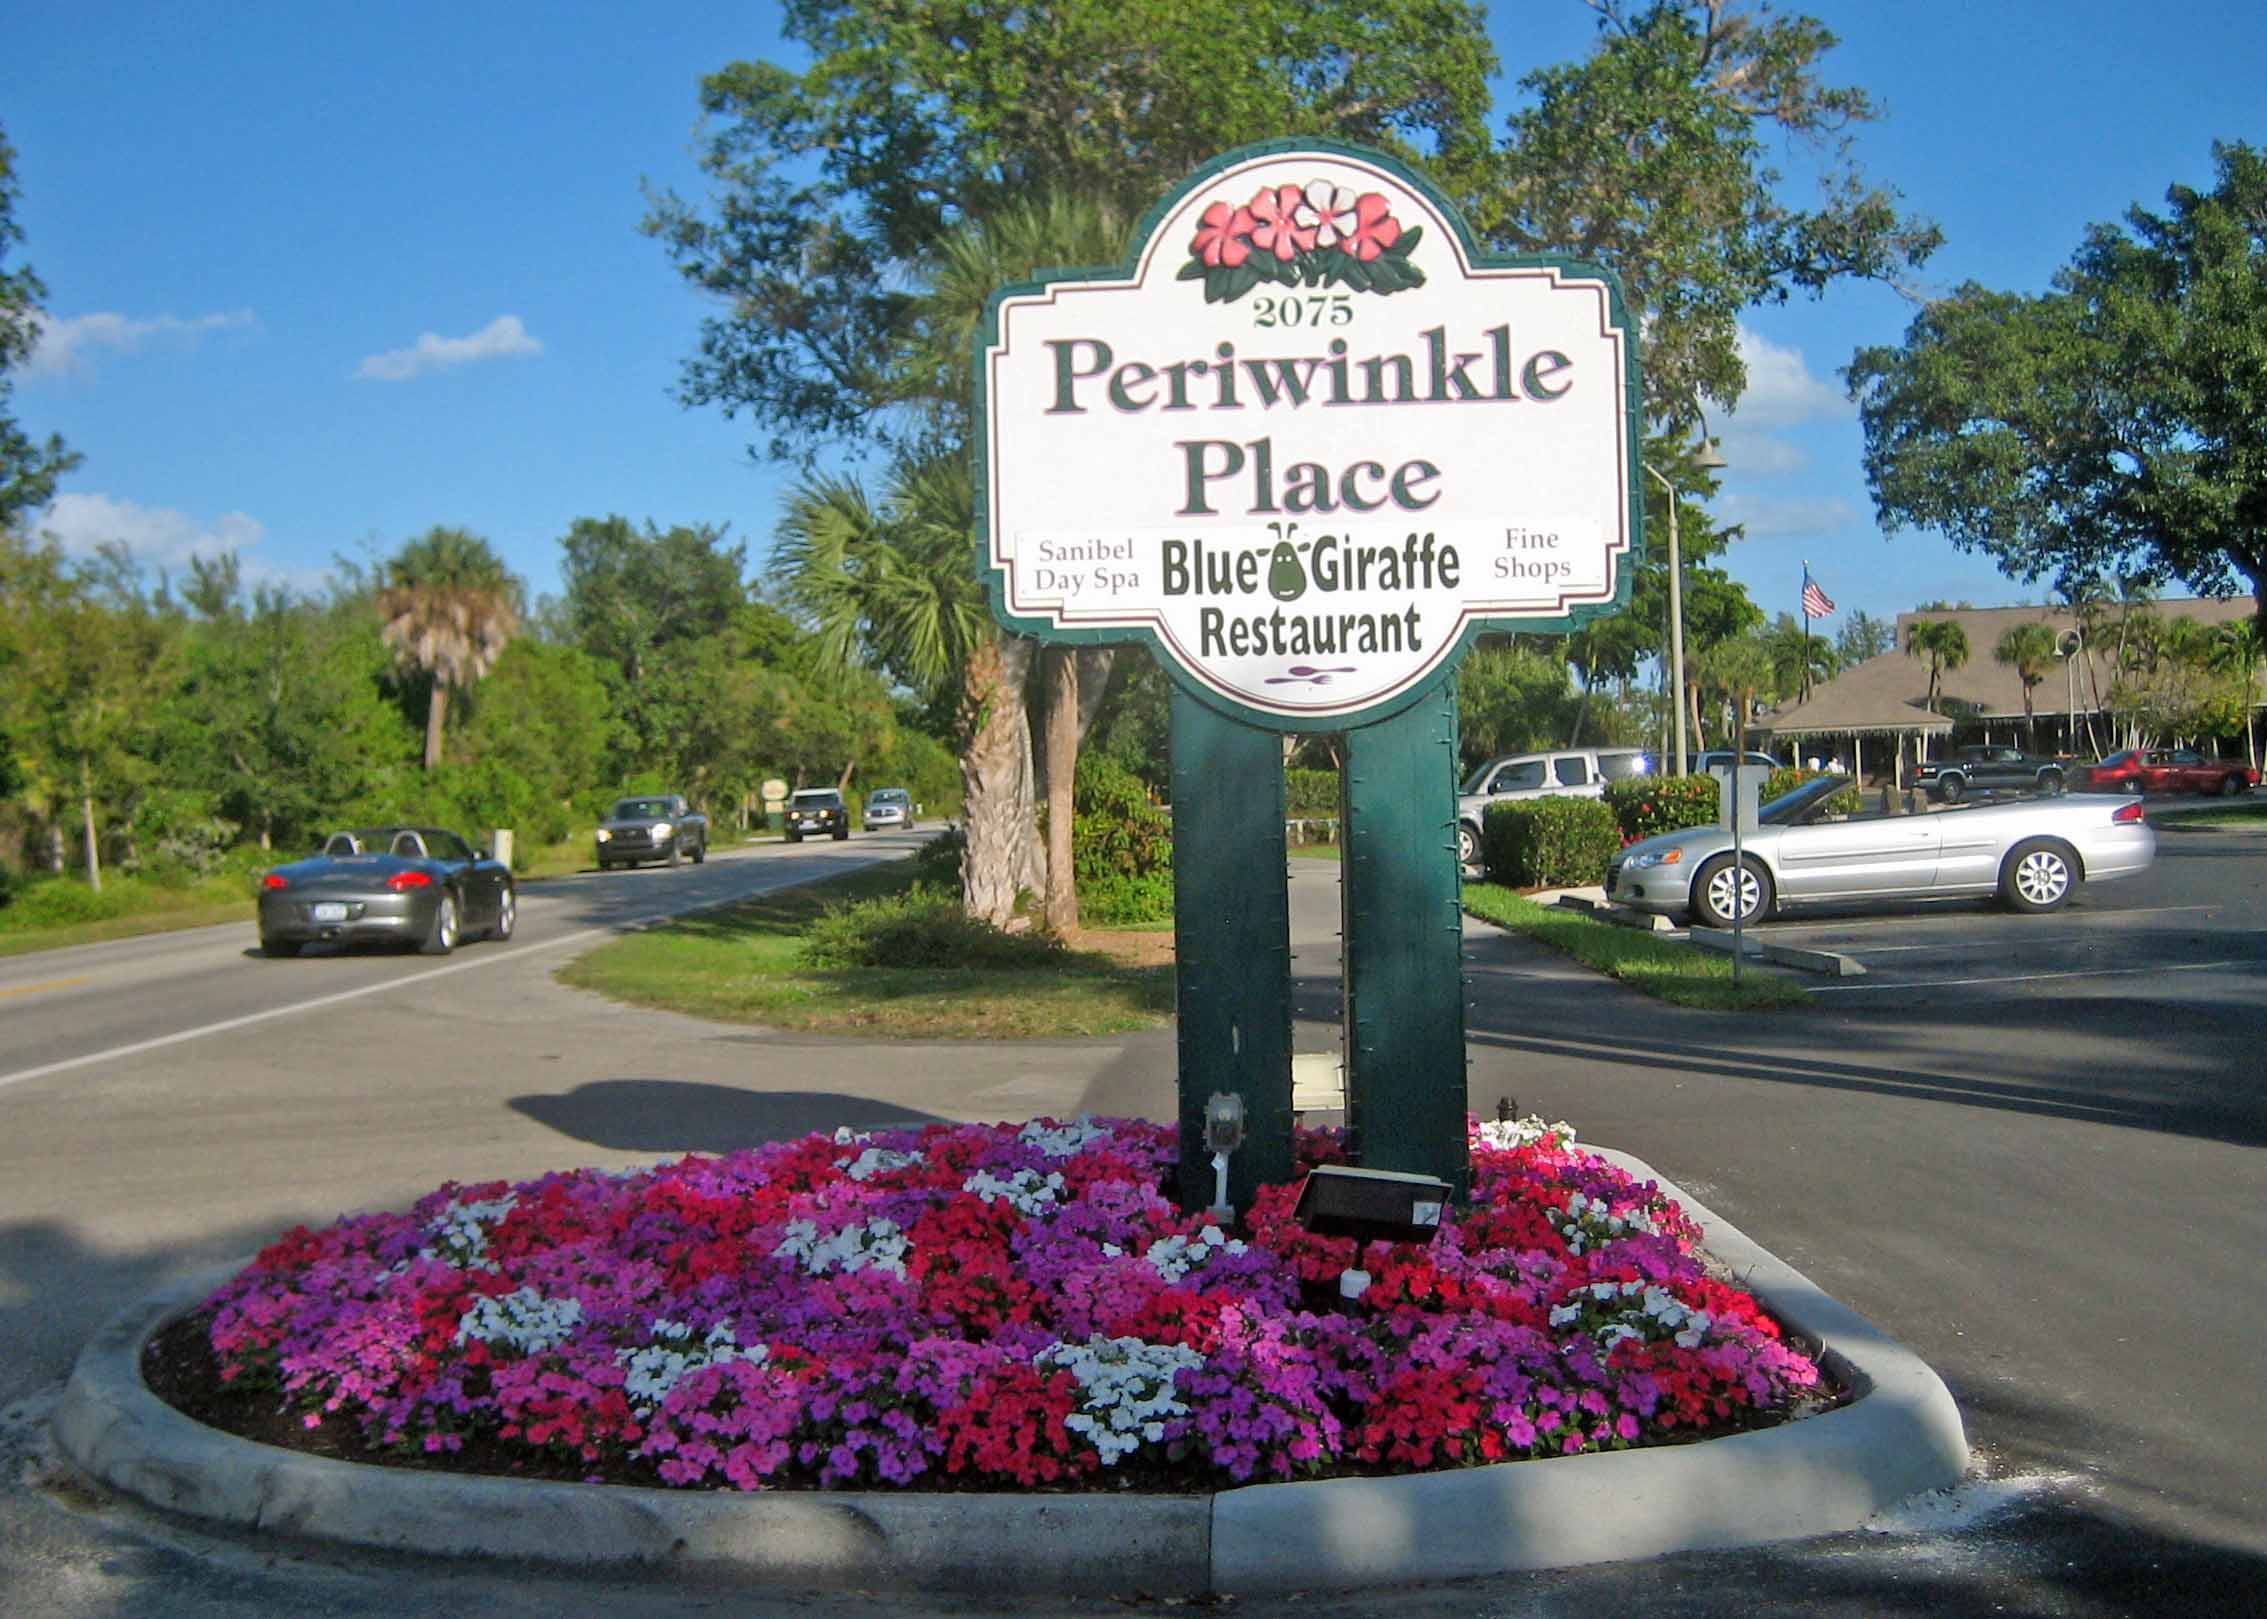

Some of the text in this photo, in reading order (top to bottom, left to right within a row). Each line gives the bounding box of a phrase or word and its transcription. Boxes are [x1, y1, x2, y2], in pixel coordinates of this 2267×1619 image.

[1252, 295, 1354, 328] 2075
[1042, 323, 1574, 415] Periwinkle
[1175, 436, 1442, 516] Place
[1038, 538, 1134, 562] Sanibel
[1505, 526, 1560, 551] Fine
[1161, 532, 1461, 596] Blue Giraffe
[1493, 554, 1572, 584] Shops
[1035, 567, 1140, 595] Day Spa
[1200, 603, 1423, 658] Restaurant
